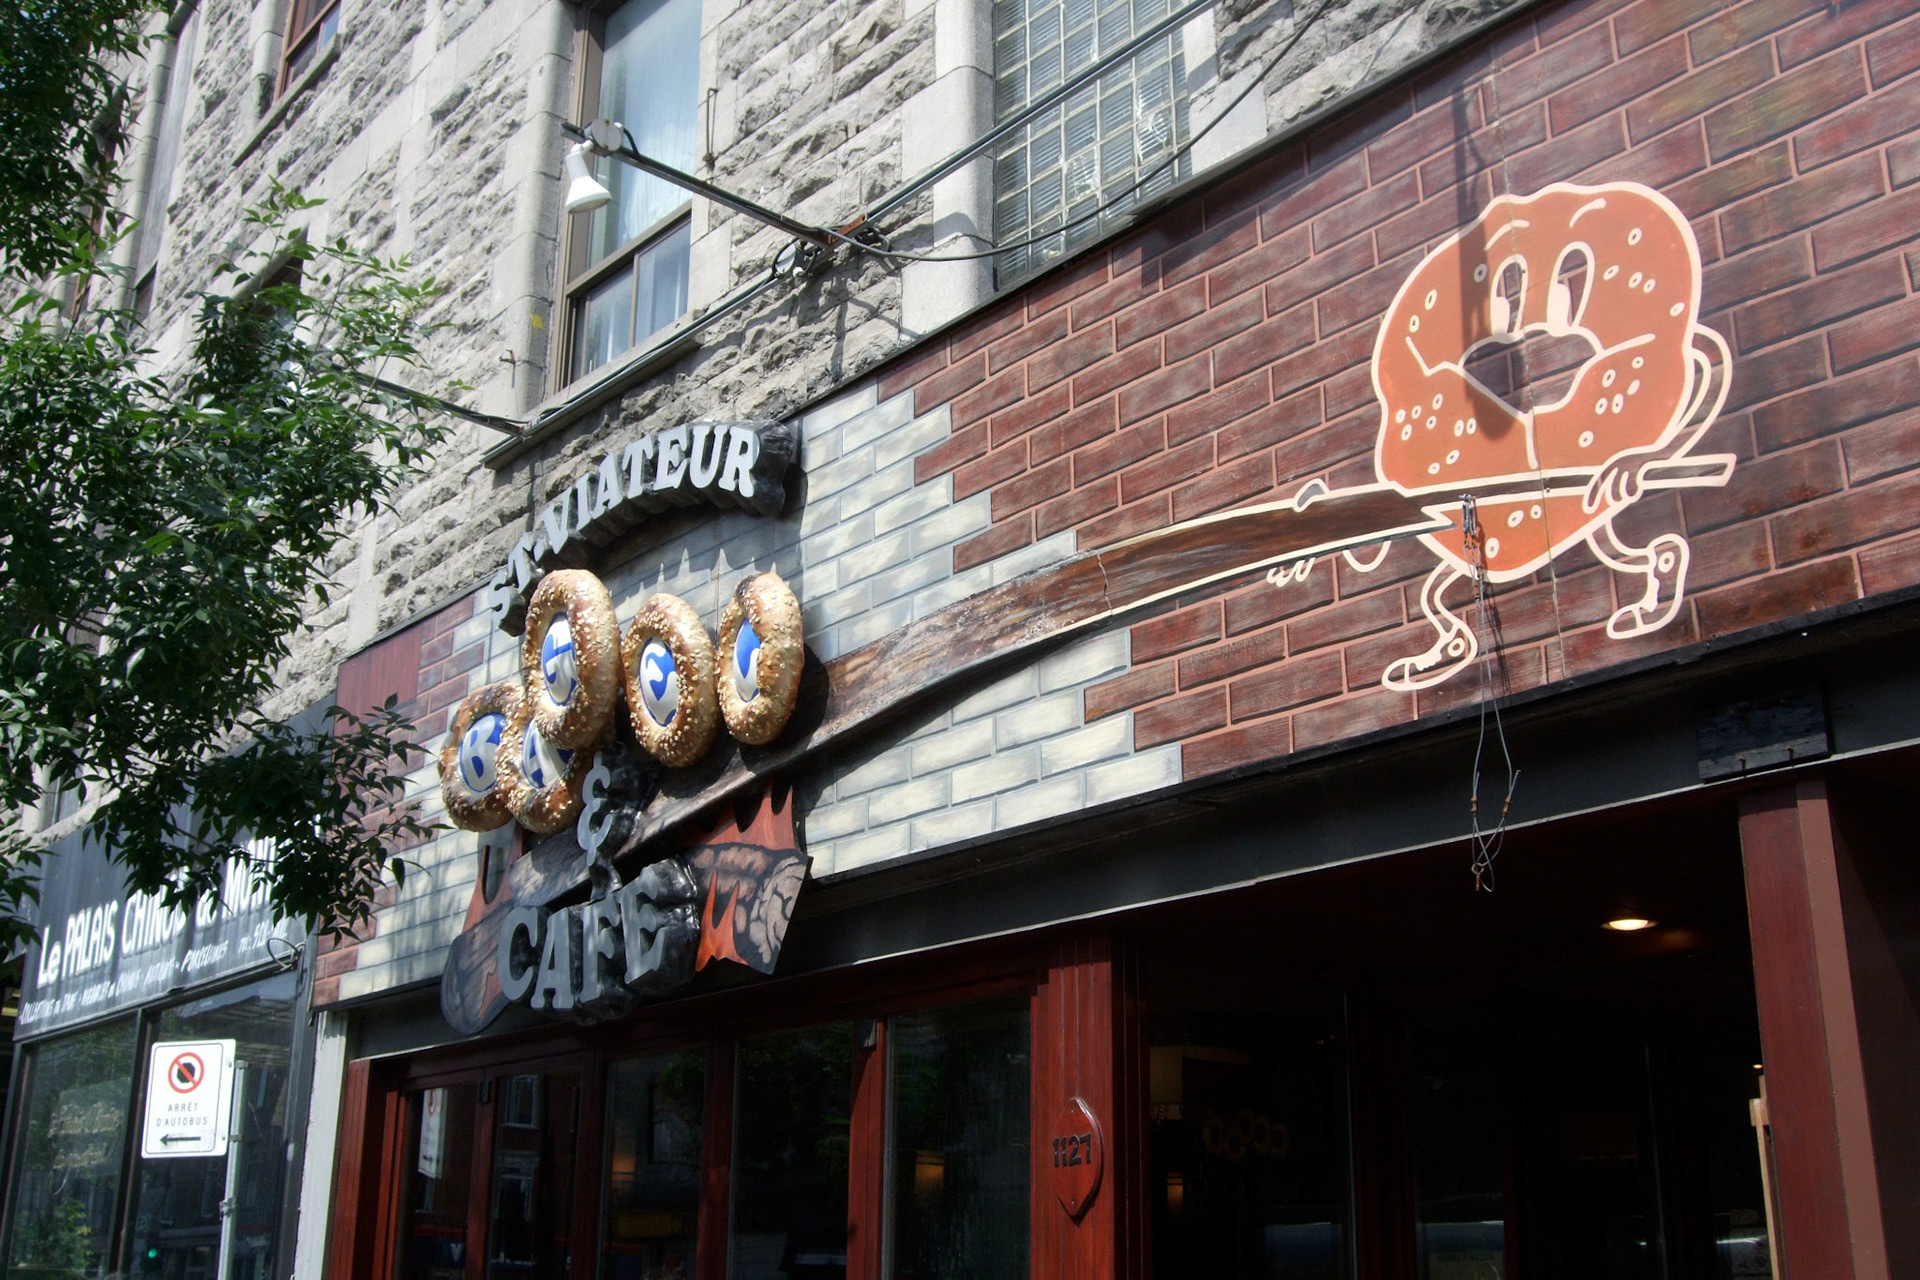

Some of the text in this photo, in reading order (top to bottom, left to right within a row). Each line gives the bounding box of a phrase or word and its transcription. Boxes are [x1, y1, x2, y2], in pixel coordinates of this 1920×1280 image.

[62, 899, 118, 979] PALAIS
[168, 1101, 199, 1113] ARRÊT
[156, 1116, 208, 1127] D'AUTOBUS
[1053, 1133, 1091, 1167] 1127
